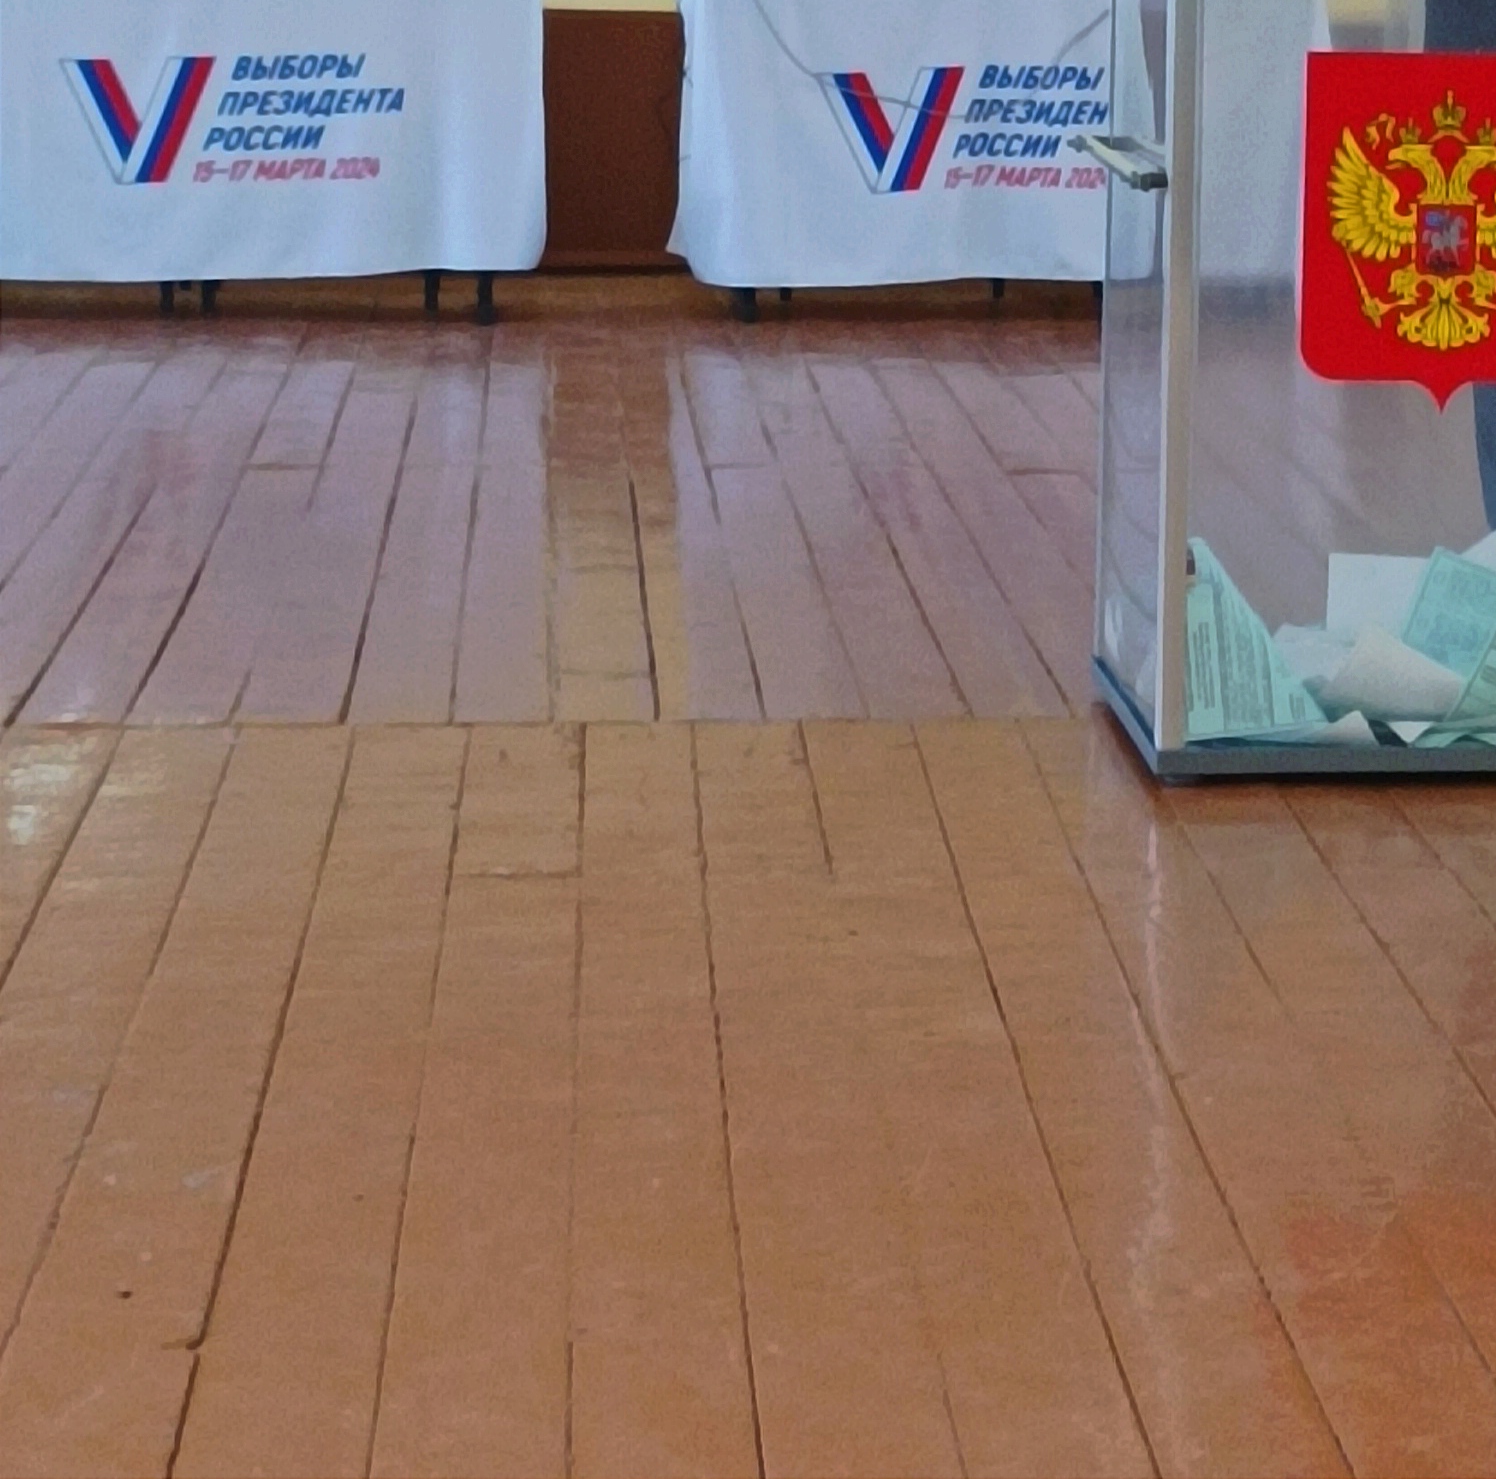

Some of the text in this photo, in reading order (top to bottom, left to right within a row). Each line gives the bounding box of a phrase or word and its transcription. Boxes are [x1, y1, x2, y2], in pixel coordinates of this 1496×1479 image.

[231, 53, 366, 81] ВЫБОРЫ
[978, 65, 1105, 91] ВЫБОРЫ
[217, 88, 404, 117] ПРЕЗИДЕНТА
[964, 99, 1109, 127] ПРЕЗИДЕН
[203, 125, 326, 151] РОССИИ
[953, 133, 1062, 159] РОССИИ
[253, 157, 326, 181] МАРТА
[329, 156, 381, 180] 2024
[995, 164, 1062, 189] МАРТА
